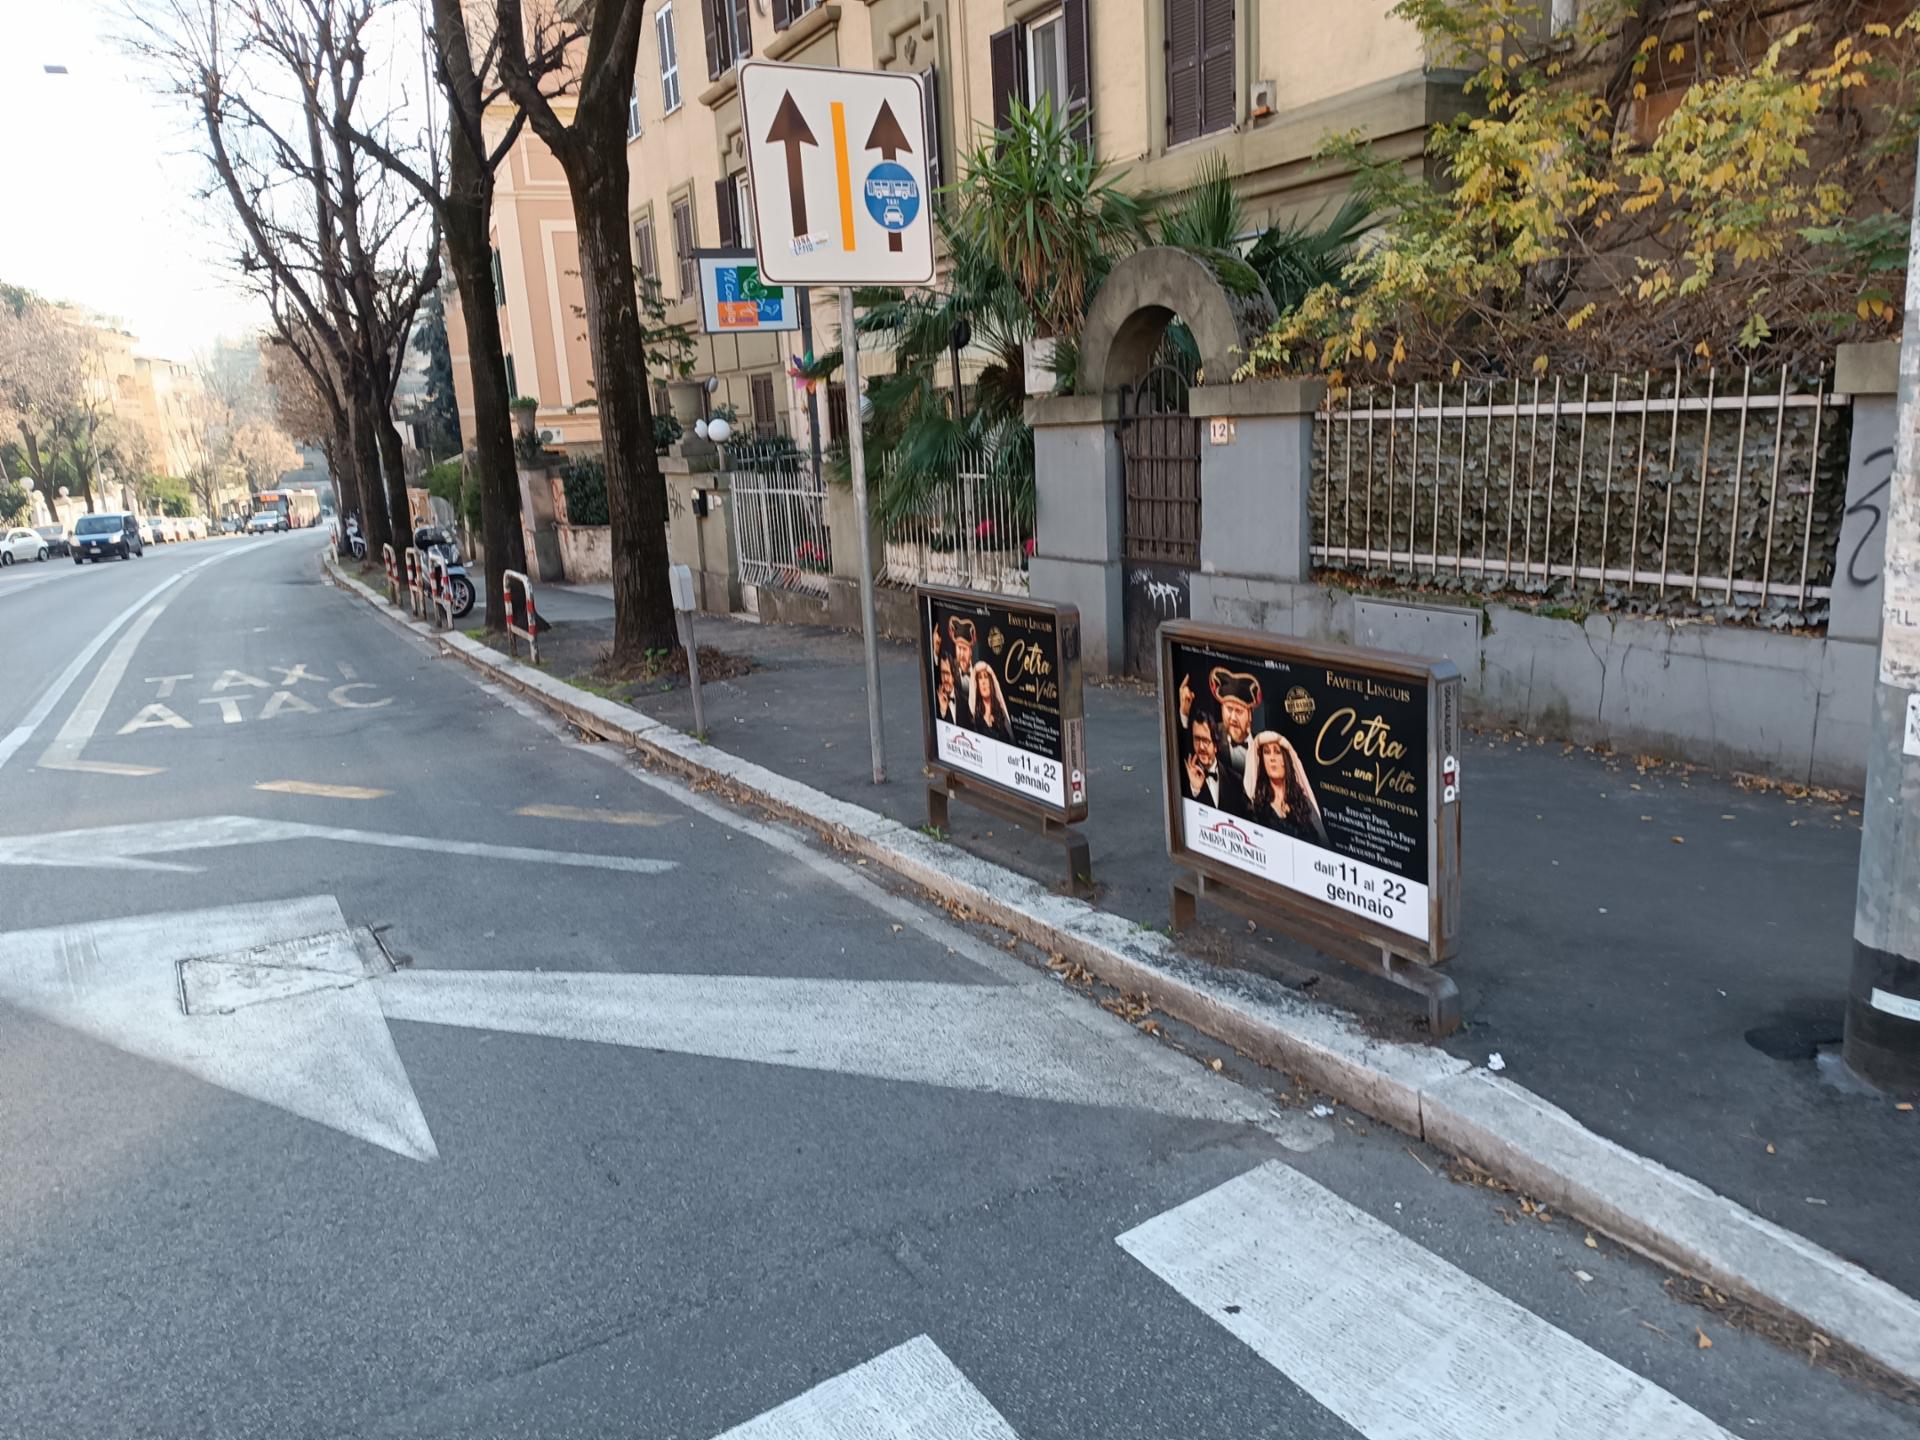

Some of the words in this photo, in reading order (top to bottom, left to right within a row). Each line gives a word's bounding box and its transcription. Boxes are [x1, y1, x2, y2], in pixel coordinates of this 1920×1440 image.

[1211, 423, 1226, 438] 12
[1005, 638, 1052, 684] Cetra
[144, 660, 358, 698] TAXI
[1326, 671, 1363, 694] FAVETE
[1367, 679, 1410, 703] LINGUIS
[115, 682, 393, 735] ATAC
[1315, 707, 1407, 766] Cetra
[1014, 771, 1051, 794] gennaio
[1043, 762, 1057, 781] 22
[1354, 768, 1374, 782] una
[1376, 761, 1416, 796] Volta
[1396, 805, 1418, 818] CETRA
[1326, 883, 1394, 919] gennaio
[1363, 878, 1375, 892] al
[1382, 878, 1407, 905] 22
